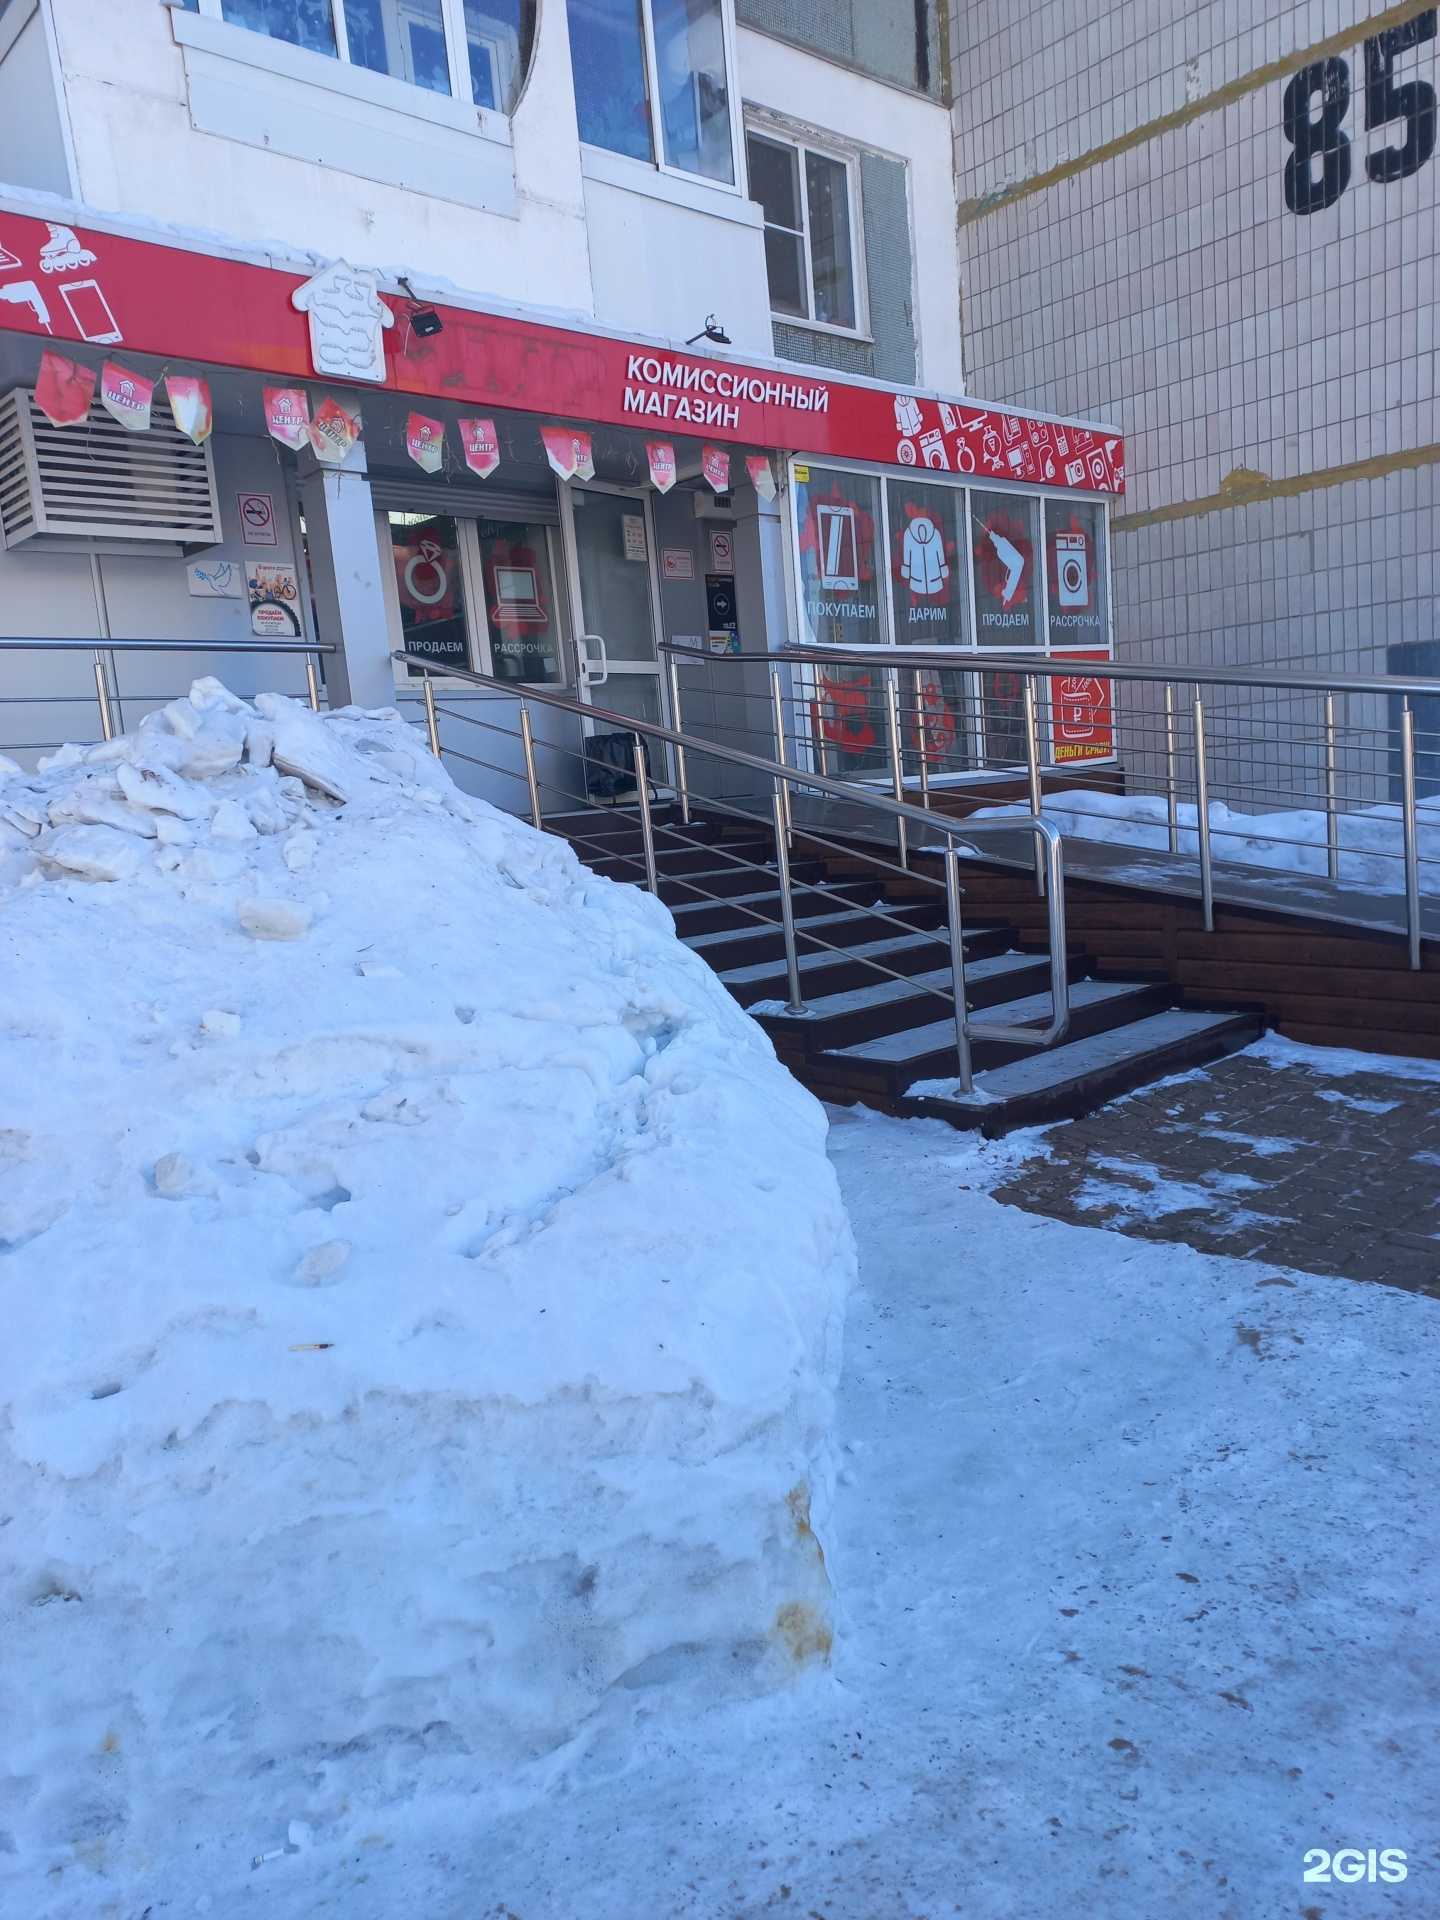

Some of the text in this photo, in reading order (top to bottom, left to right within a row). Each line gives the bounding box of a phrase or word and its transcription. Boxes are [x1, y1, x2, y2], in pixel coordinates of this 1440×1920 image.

[1284, 8, 1437, 216] 85
[627, 355, 829, 412] КОМИССИОННЫЙ
[106, 391, 146, 411] ЦЕНТР
[623, 387, 740, 428] МАГАЗИН
[272, 415, 303, 425] ЦЕНТР
[469, 443, 495, 453] ЦЕНТР
[653, 462, 673, 471] ЦЕНТР
[807, 601, 876, 618] ПОКУПАЕМ
[909, 607, 947, 623] ДАРИМ
[982, 613, 1029, 628] ПРОДАЕМ
[1050, 615, 1101, 627] РАССРОЧКА
[408, 641, 463, 653] ПРОДАЕМ
[1056, 745, 1082, 758] ДЕНЬГИ
